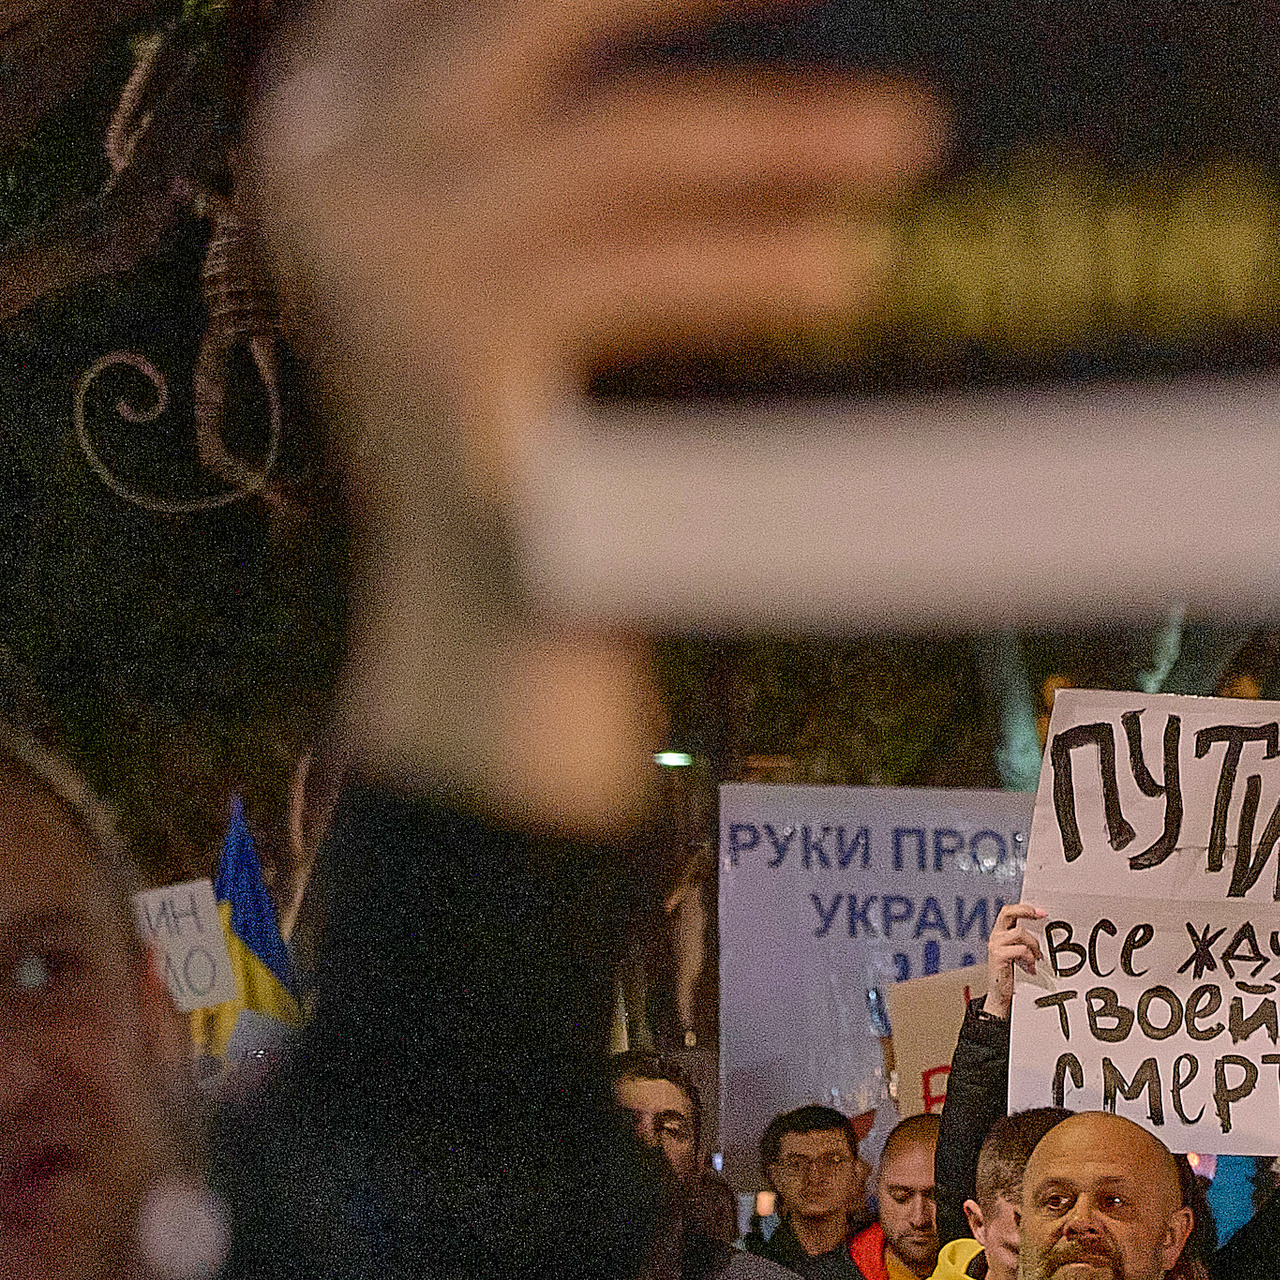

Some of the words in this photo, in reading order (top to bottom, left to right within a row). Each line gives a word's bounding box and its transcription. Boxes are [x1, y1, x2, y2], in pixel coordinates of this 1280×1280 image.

[727, 823, 873, 869] РУКИ
[890, 827, 1026, 871] ПРО
[810, 892, 1003, 940] УКРАИ
